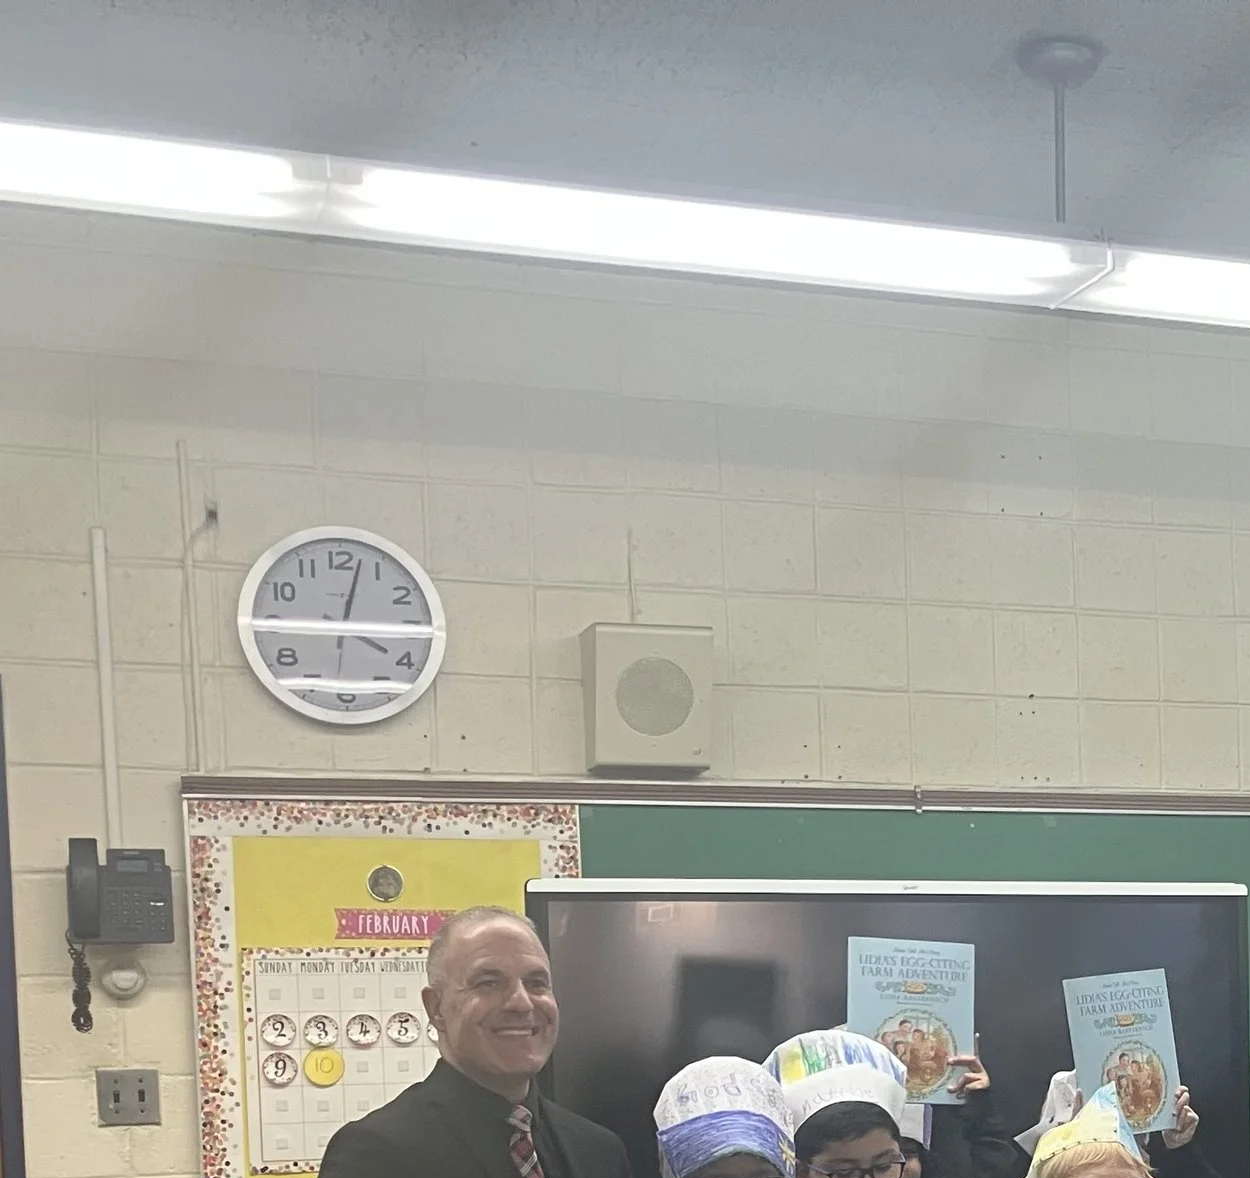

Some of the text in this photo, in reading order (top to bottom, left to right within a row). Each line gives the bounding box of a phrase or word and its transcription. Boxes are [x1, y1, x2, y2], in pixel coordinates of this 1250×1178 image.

[298, 558, 316, 579] 11
[328, 550, 354, 571] 12
[375, 562, 381, 581] 1
[273, 582, 296, 602] 10
[392, 585, 412, 606] 2
[276, 647, 299, 667] 8
[395, 651, 415, 670] 4
[358, 914, 430, 935] FEBRUARY
[258, 961, 293, 974] SUNDAY
[300, 961, 335, 973] MONDAY
[340, 960, 376, 973] TUESDAY
[272, 1018, 410, 1040] 2 3 4 5
[274, 1056, 335, 1077] 9 10
